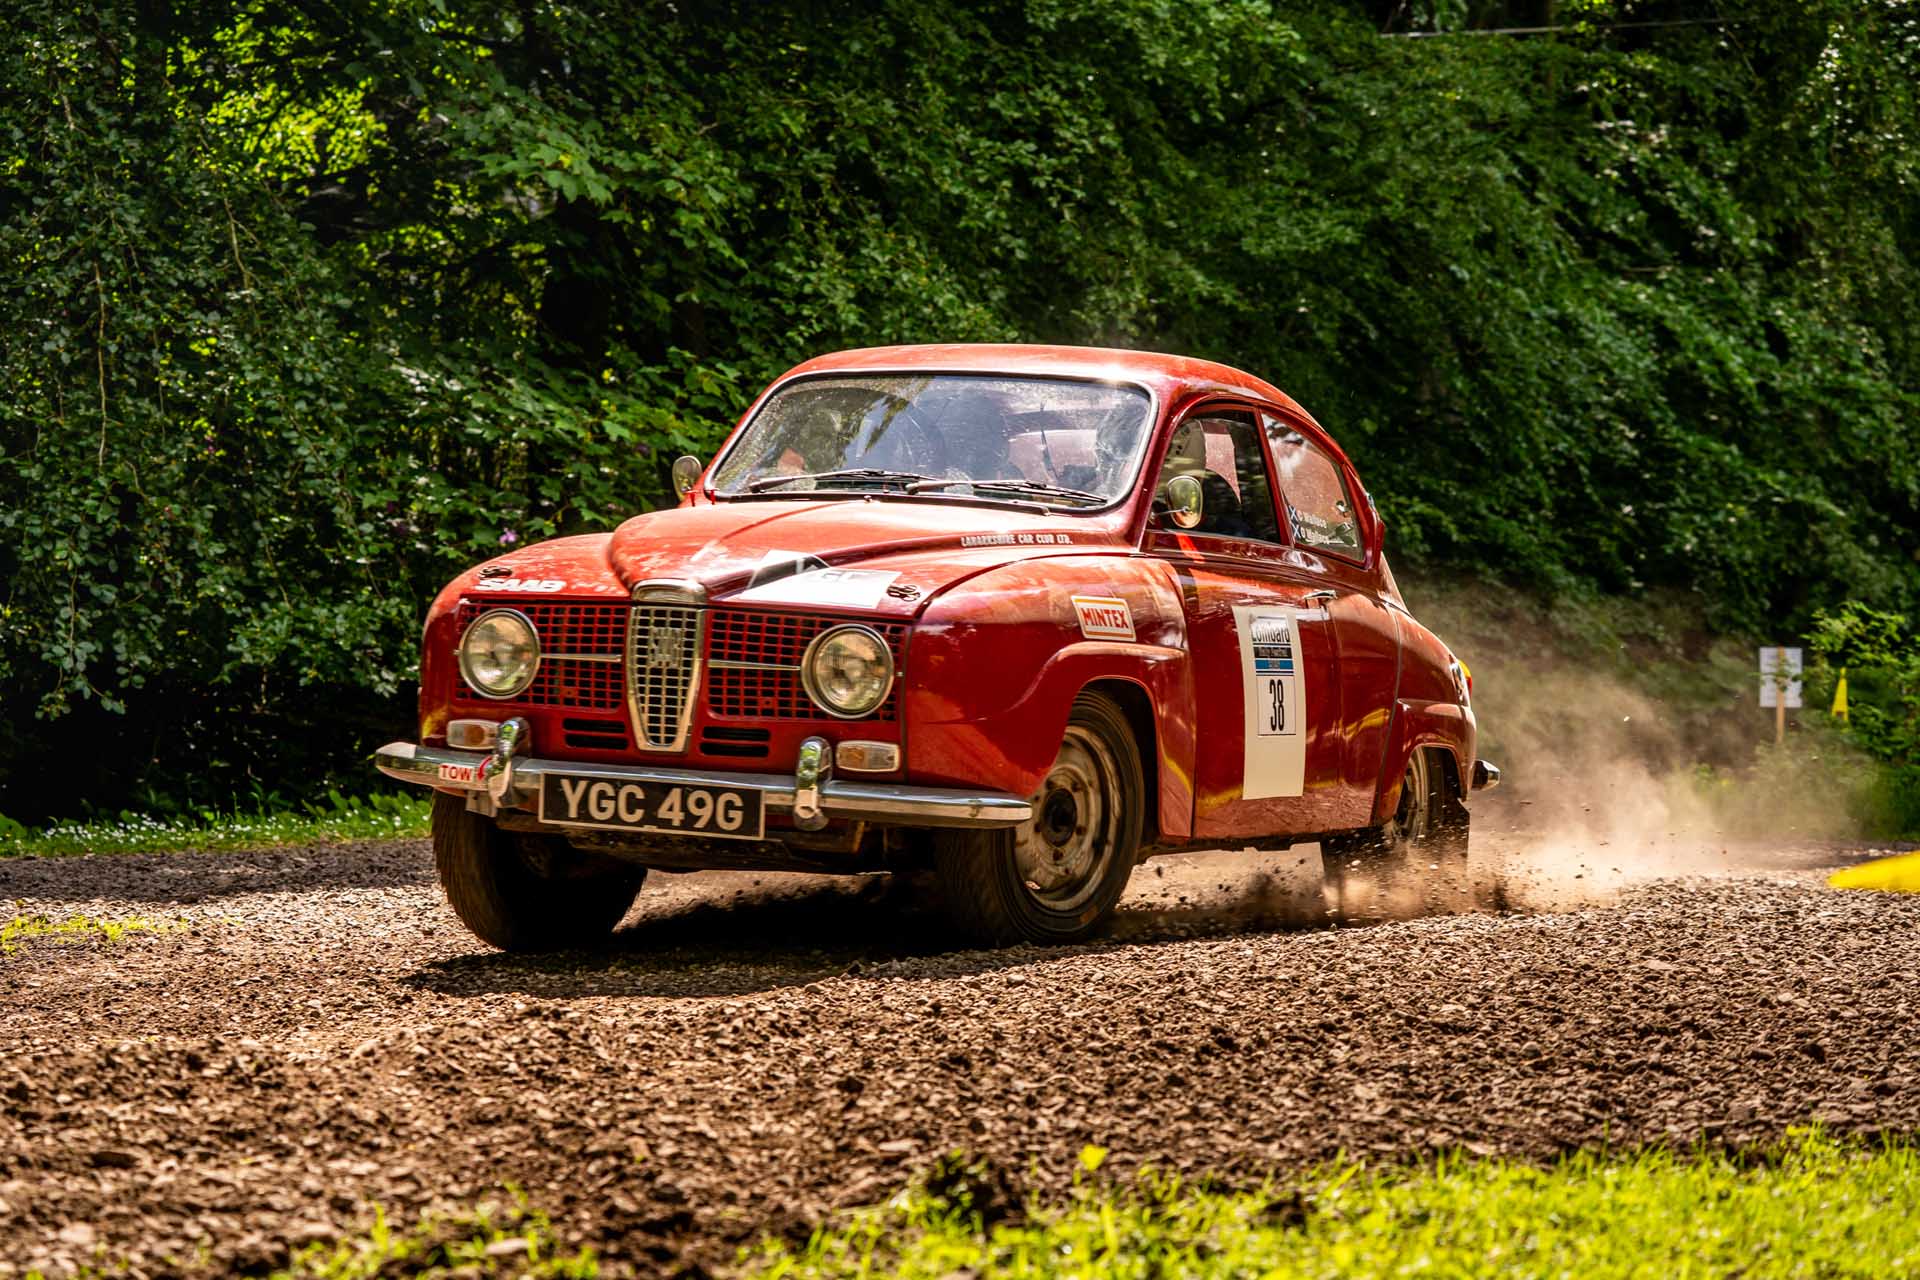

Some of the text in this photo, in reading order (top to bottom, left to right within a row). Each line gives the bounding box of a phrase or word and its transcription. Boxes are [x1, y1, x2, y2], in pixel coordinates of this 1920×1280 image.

[1018, 534, 1035, 545] CAR
[1035, 534, 1055, 544] CLUB
[474, 578, 567, 593] SAAB
[1080, 607, 1129, 629] MINTEX
[1269, 679, 1285, 731] 38
[440, 764, 471, 781] TOW
[560, 777, 744, 832] YGC 49G
